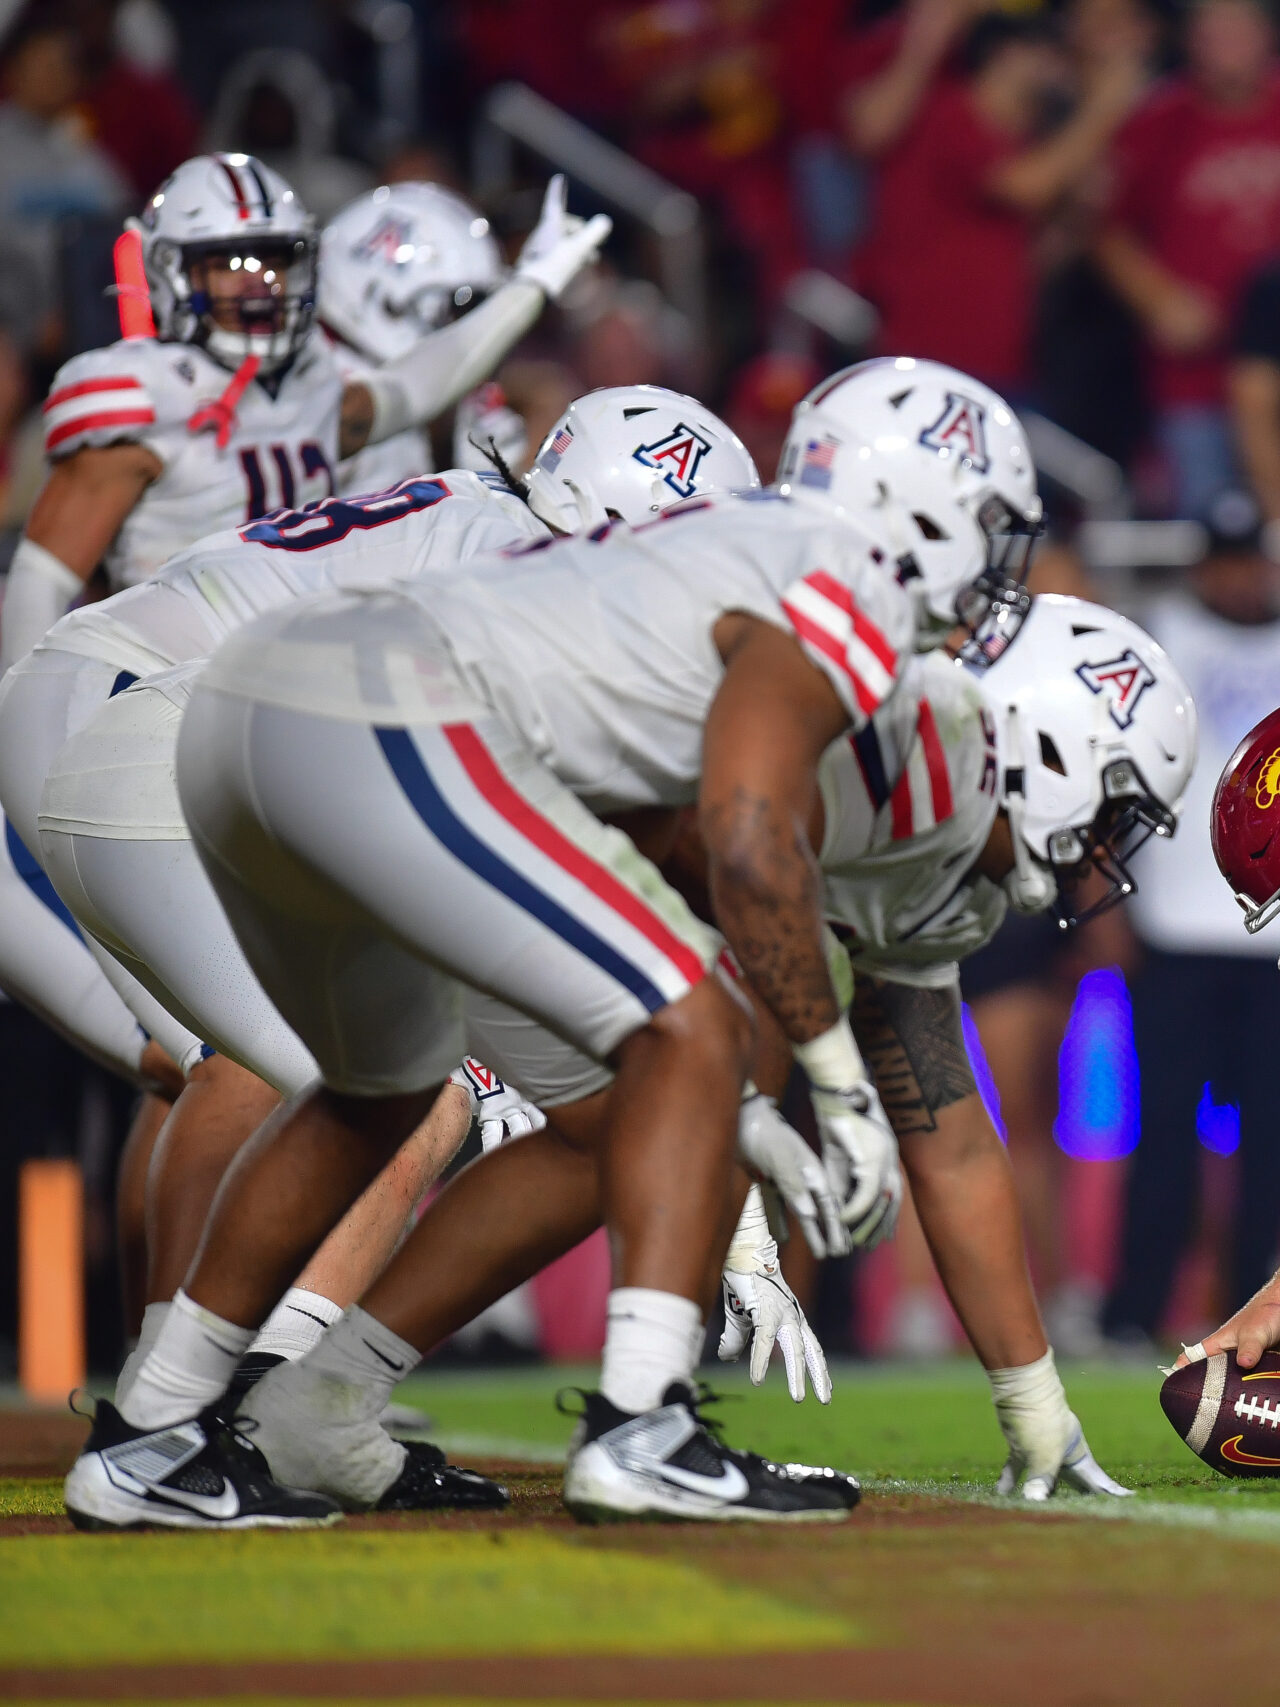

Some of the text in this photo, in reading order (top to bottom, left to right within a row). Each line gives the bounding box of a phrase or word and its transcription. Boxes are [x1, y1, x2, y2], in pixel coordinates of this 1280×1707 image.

[632, 421, 712, 498] A
[922, 389, 990, 475] A
[1074, 648, 1157, 732] A
